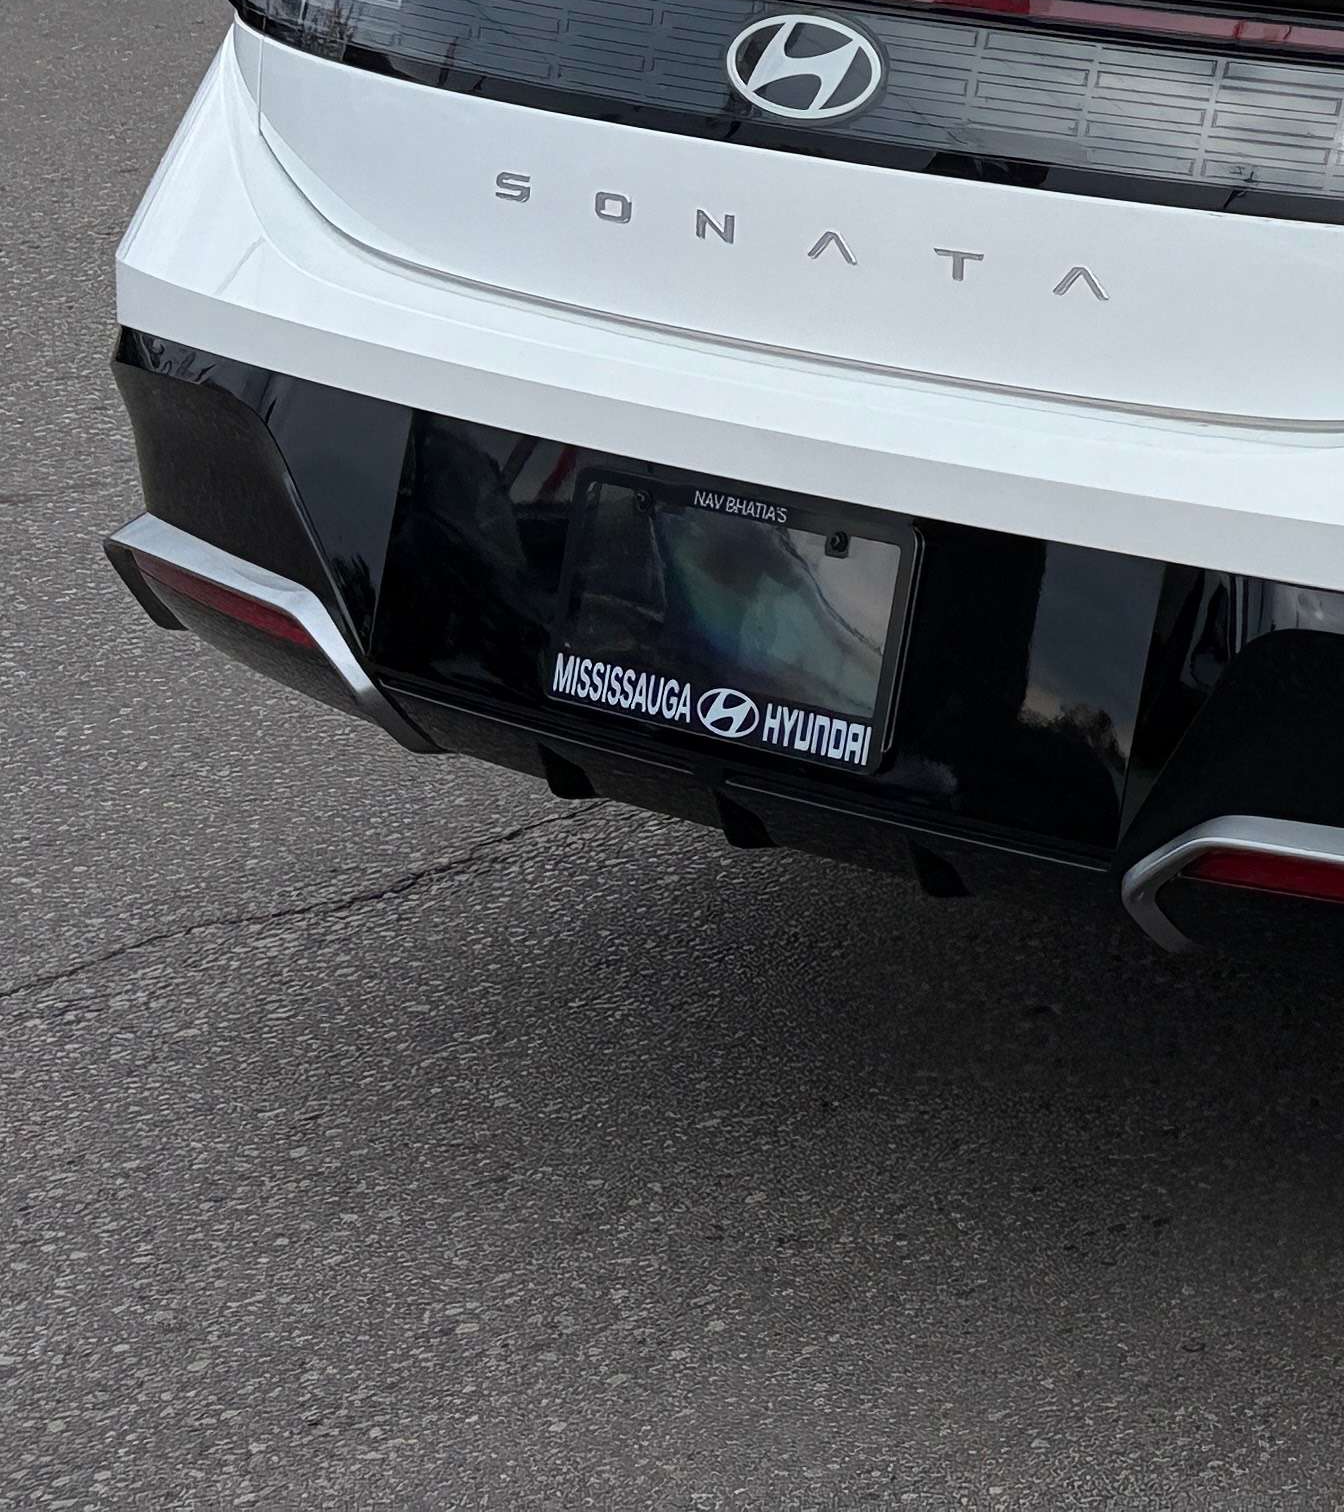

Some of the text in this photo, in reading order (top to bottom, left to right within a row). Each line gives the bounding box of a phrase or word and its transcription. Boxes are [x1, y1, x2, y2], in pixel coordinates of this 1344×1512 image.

[495, 171, 1111, 301] SONATA
[693, 490, 788, 523] NAV BHATIA'S
[552, 652, 873, 766] MISSISSAUGA HYUNDAI
